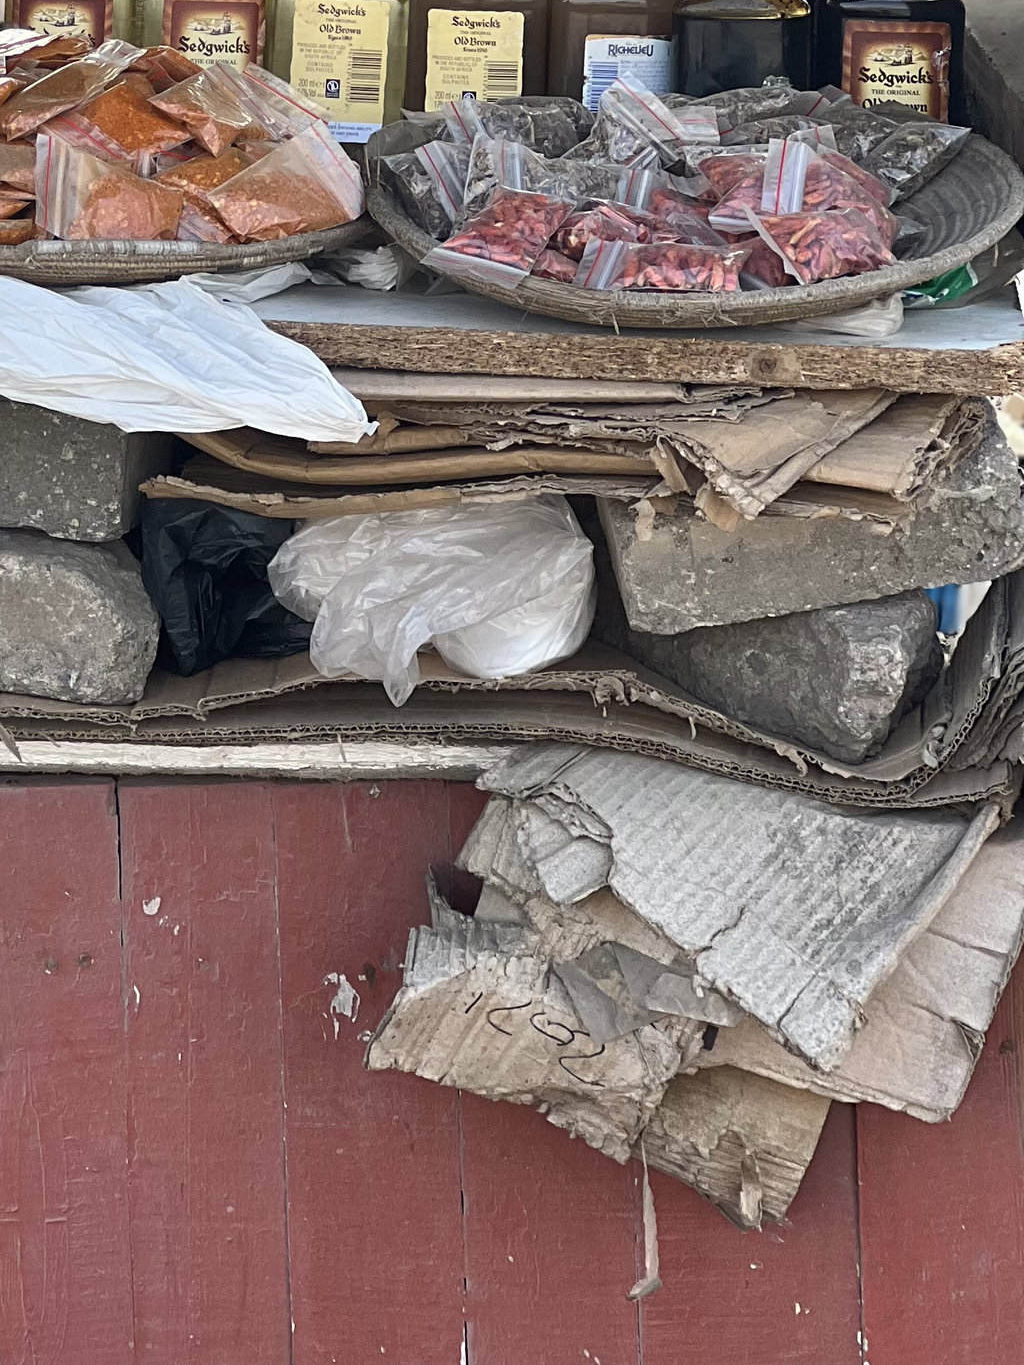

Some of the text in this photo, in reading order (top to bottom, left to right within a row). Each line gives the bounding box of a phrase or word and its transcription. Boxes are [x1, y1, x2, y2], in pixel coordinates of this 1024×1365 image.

[317, 3, 366, 18] Sedgwick's
[319, 24, 362, 34] Old Brown
[452, 16, 501, 30] Sedgwick's
[177, 36, 251, 56] Sedgwick's
[454, 36, 496, 47] Old Brown
[608, 44, 654, 57] RICHELIEU
[858, 66, 934, 88] Sedgwick's
